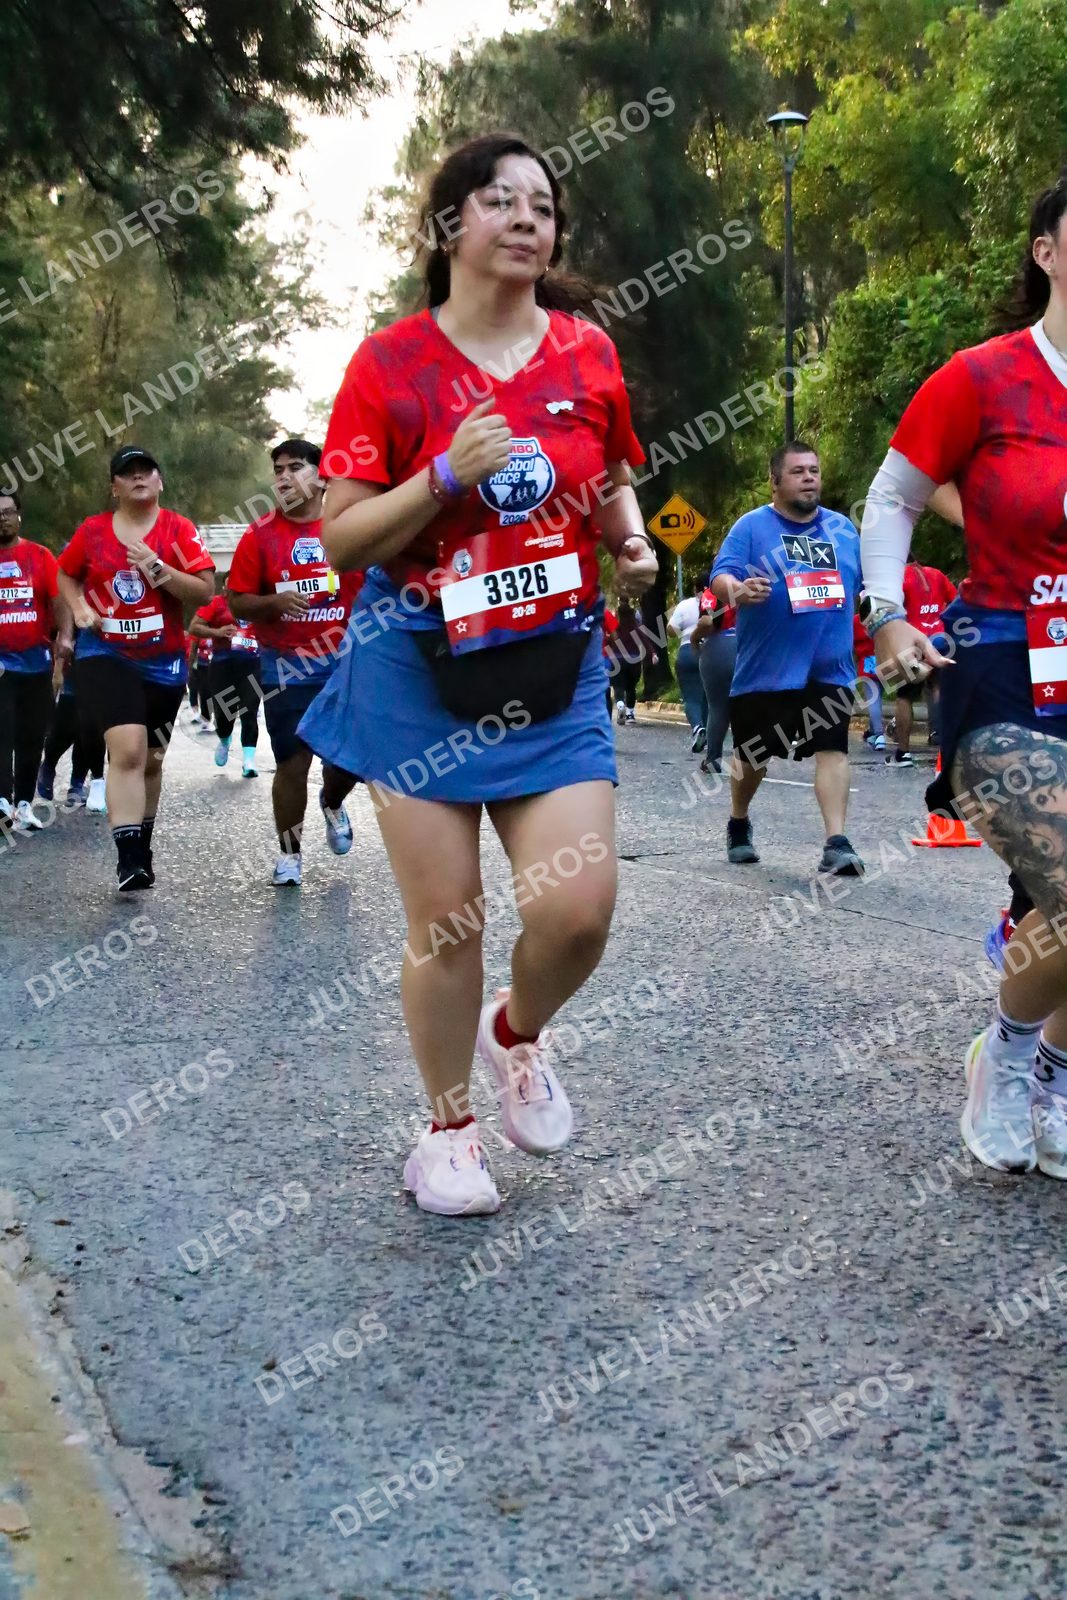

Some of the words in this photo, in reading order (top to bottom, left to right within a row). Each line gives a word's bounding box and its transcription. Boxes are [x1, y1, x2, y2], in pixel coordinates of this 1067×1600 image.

[500, 458, 535, 472] obal
[489, 472, 520, 485] Race
[296, 579, 320, 593] 1416
[483, 563, 549, 606] 3326
[1, 588, 19, 599] 2712
[806, 586, 830, 598] 1202
[119, 620, 141, 633] 1417
